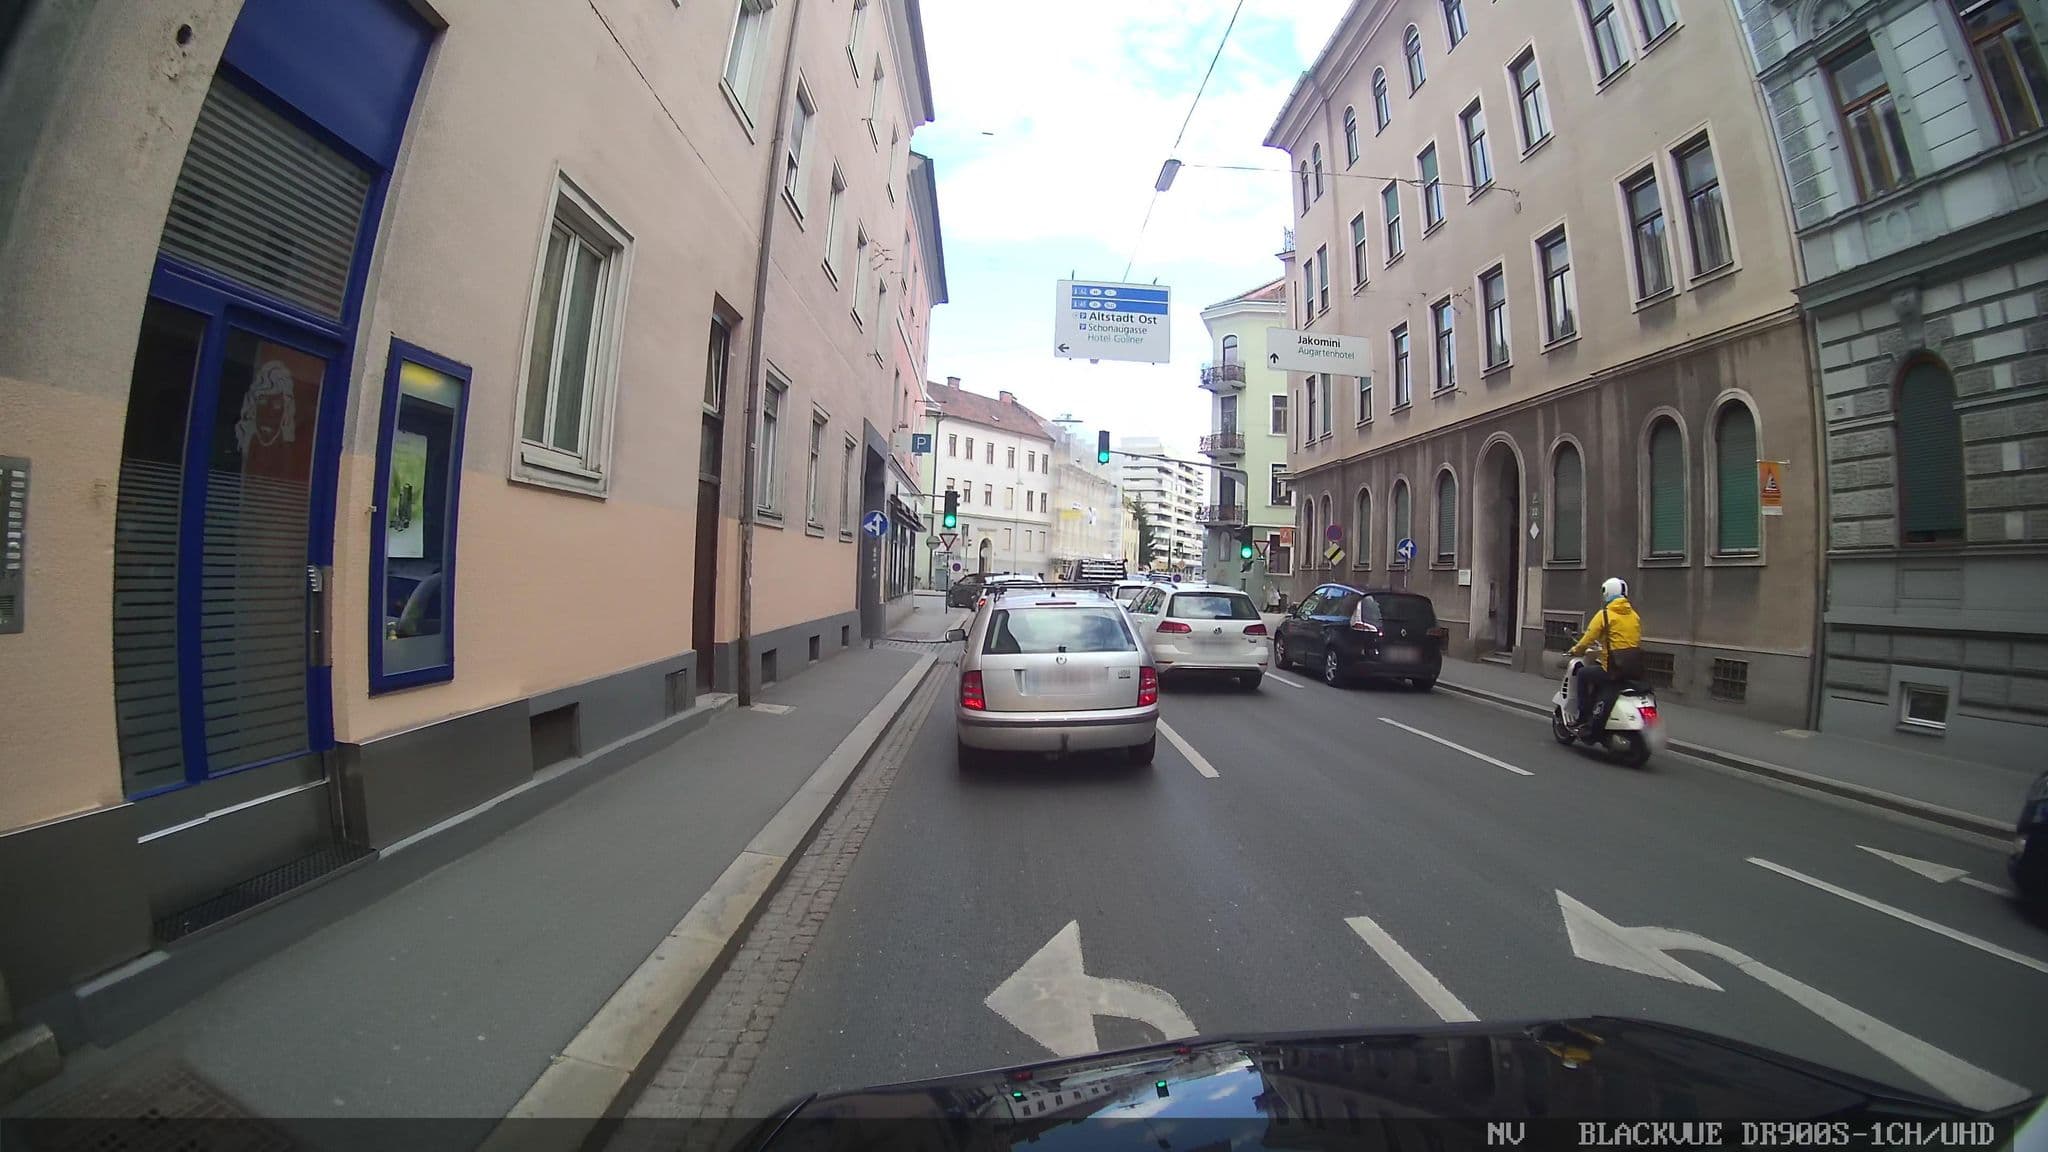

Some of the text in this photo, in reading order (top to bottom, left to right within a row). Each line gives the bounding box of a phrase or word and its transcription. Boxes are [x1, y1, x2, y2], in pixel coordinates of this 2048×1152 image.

[1089, 312, 1157, 325] Altstadt Ost
[1087, 334, 1111, 343] Hotel
[1298, 336, 1341, 348] Jakomini
[1298, 347, 1355, 359] Augartenhotel
[916, 436, 927, 450] P
